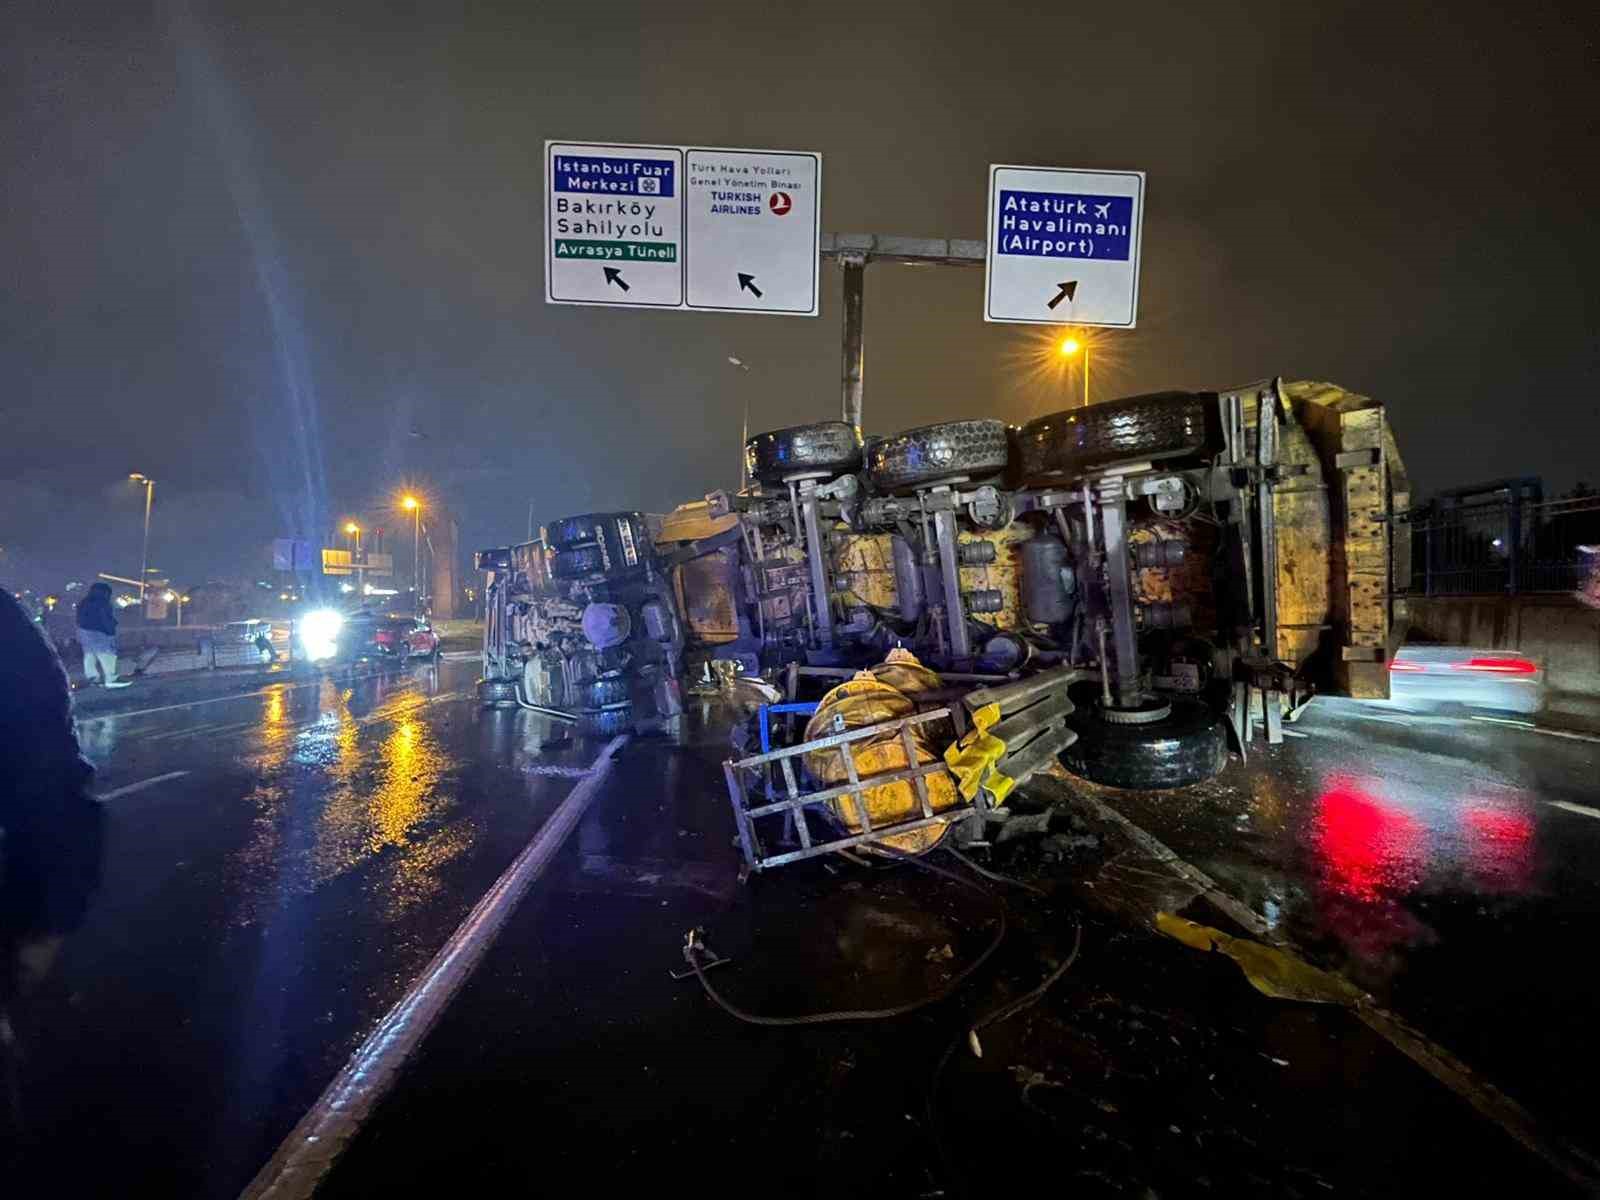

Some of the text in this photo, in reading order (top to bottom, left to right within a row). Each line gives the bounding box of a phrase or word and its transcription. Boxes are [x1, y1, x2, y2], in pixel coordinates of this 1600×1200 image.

[632, 163, 671, 176] Fuar
[720, 164, 749, 175] Hava
[568, 177, 634, 191] Merkezi
[690, 177, 721, 186] Genel
[711, 191, 761, 202] TURKISH
[557, 198, 655, 219] Bakırköy
[711, 204, 761, 215] AIRLINES
[1004, 196, 1087, 215] Atatürk
[557, 218, 663, 238] Sahilyolu
[1003, 215, 1127, 236] Havalimanı
[558, 242, 675, 259] Avrasya Tüneli
[1002, 234, 1094, 257] (Airport)
